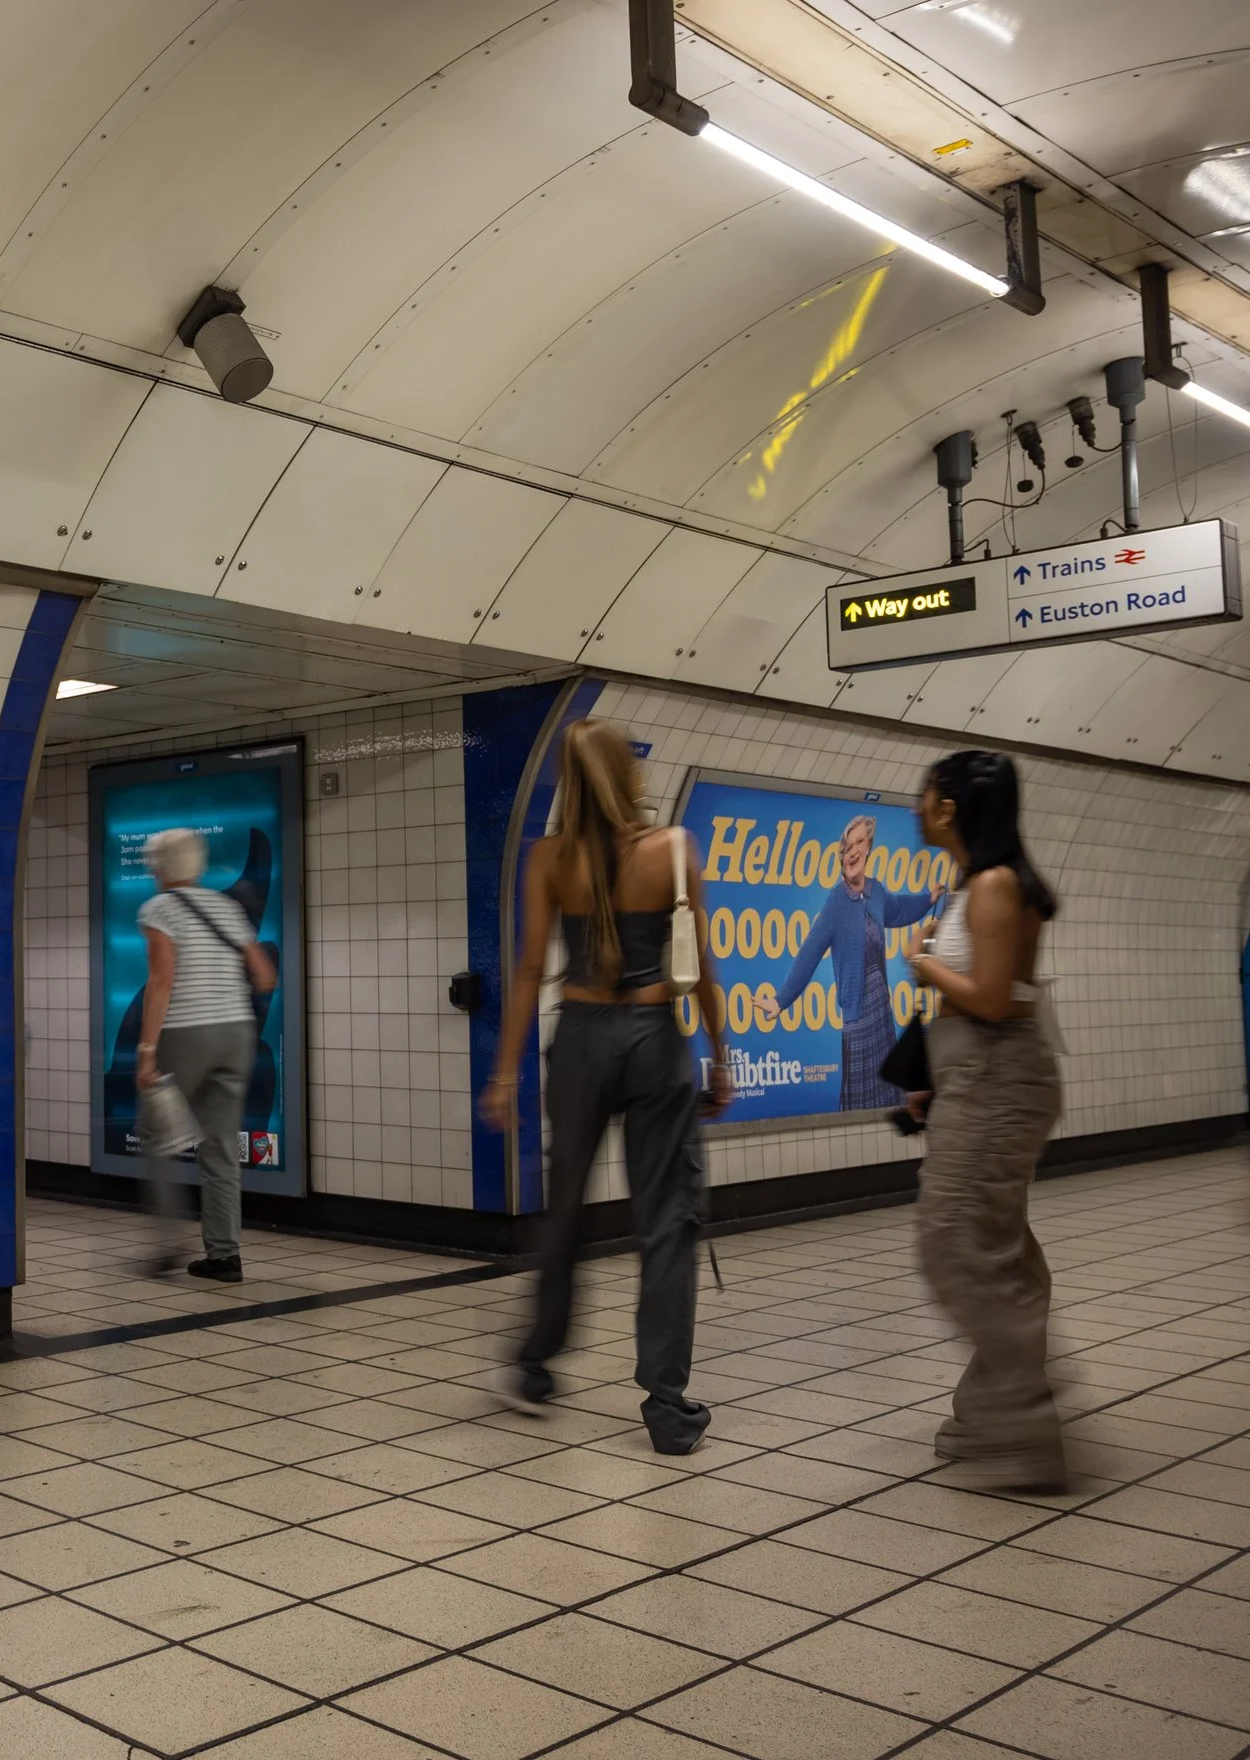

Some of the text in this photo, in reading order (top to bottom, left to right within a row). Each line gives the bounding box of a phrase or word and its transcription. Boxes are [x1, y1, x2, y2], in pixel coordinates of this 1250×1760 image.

[1038, 554, 1106, 580] Trains
[864, 589, 950, 618] Way out
[1040, 585, 1186, 623] Euston Road
[747, 1088, 765, 1097] Musical
